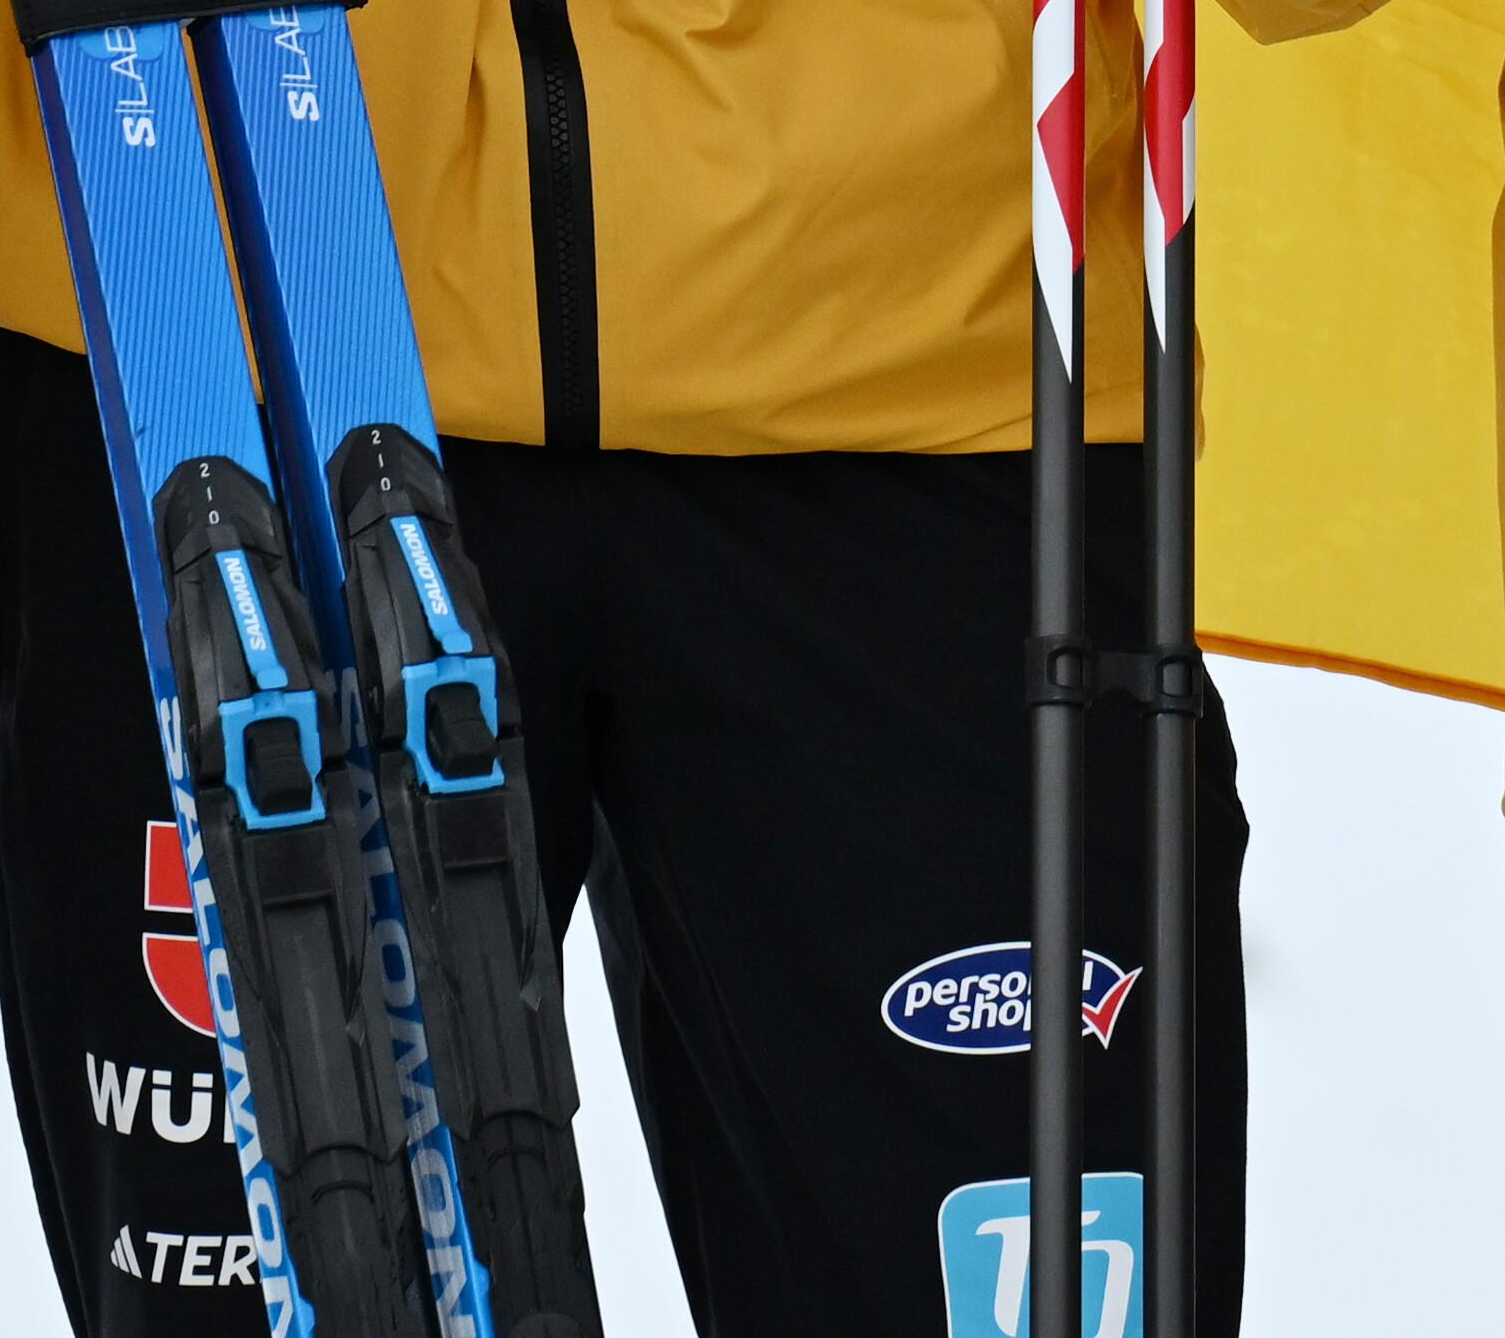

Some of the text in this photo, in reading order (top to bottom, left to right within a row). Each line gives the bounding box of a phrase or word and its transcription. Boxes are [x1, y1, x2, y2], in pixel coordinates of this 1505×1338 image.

[371, 429, 382, 445] 2
[199, 462, 211, 478] 2
[399, 522, 449, 616] SALOMON
[223, 557, 267, 651] SALOMON
